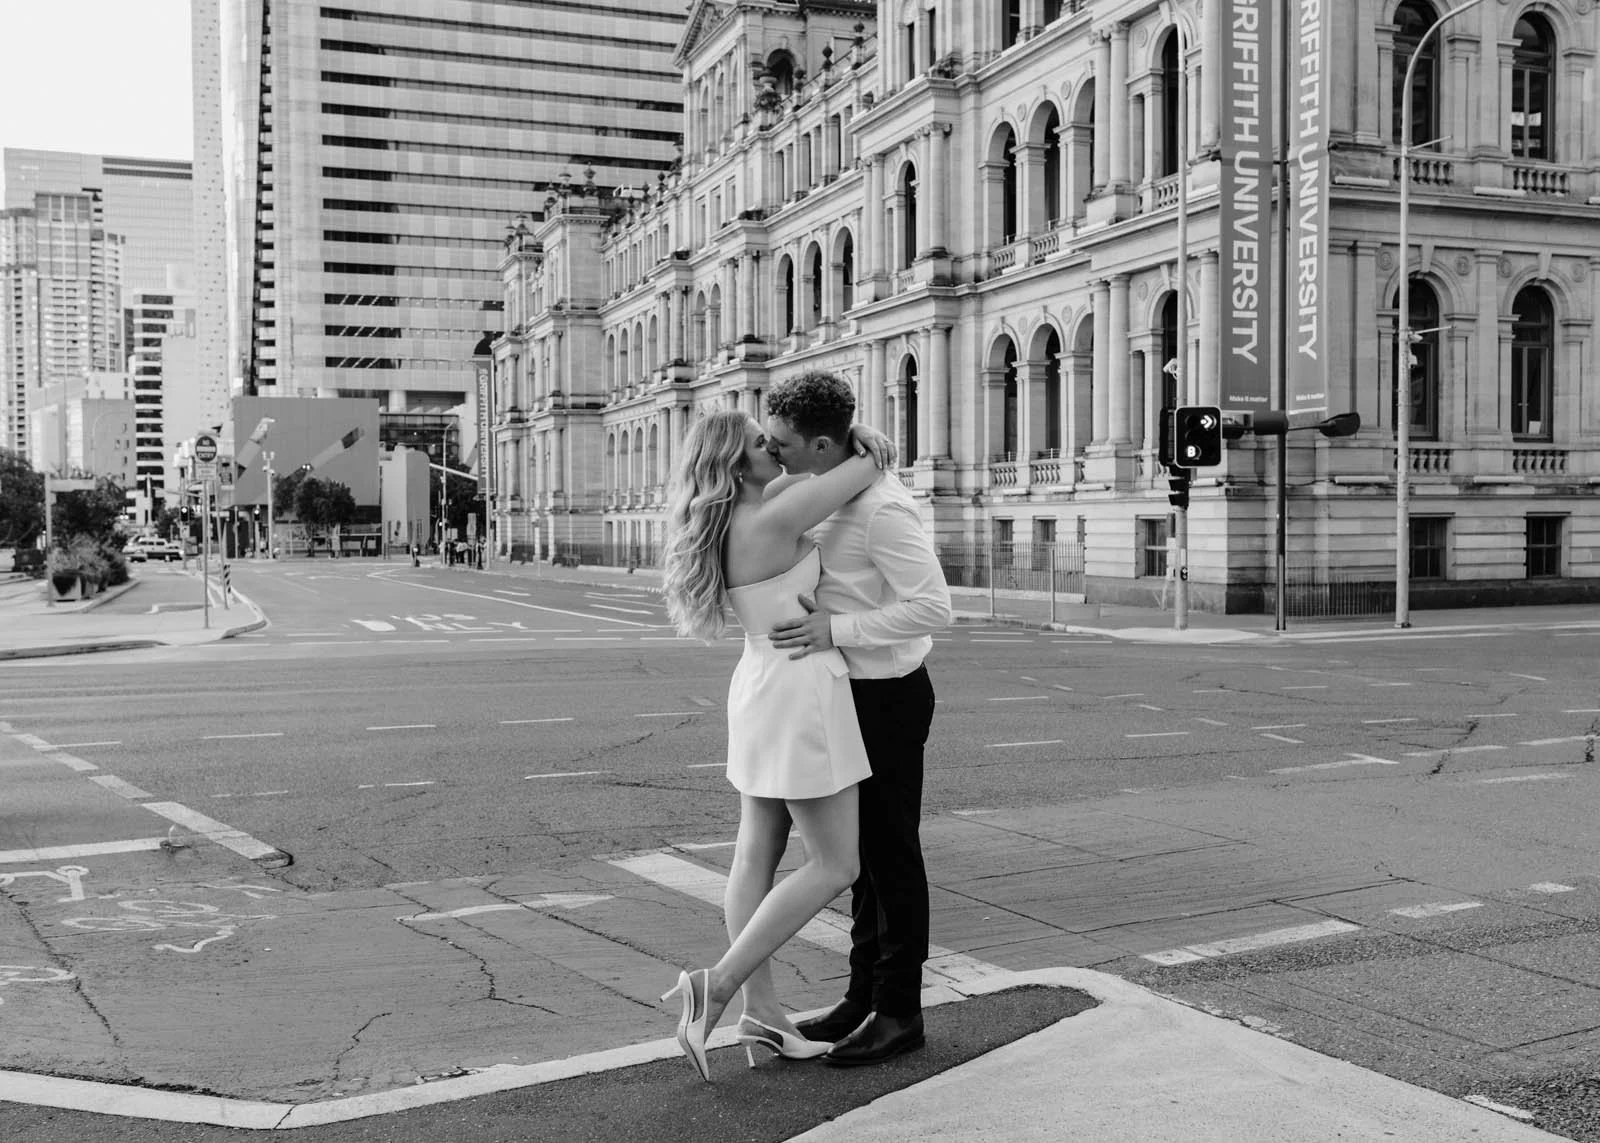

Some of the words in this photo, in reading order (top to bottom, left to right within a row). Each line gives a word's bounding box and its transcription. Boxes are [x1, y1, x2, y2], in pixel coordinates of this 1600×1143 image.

[1232, 150, 1260, 365] UNIVERSITY
[1298, 142, 1320, 361] UNIVERSITY
[1187, 445, 1196, 458] B
